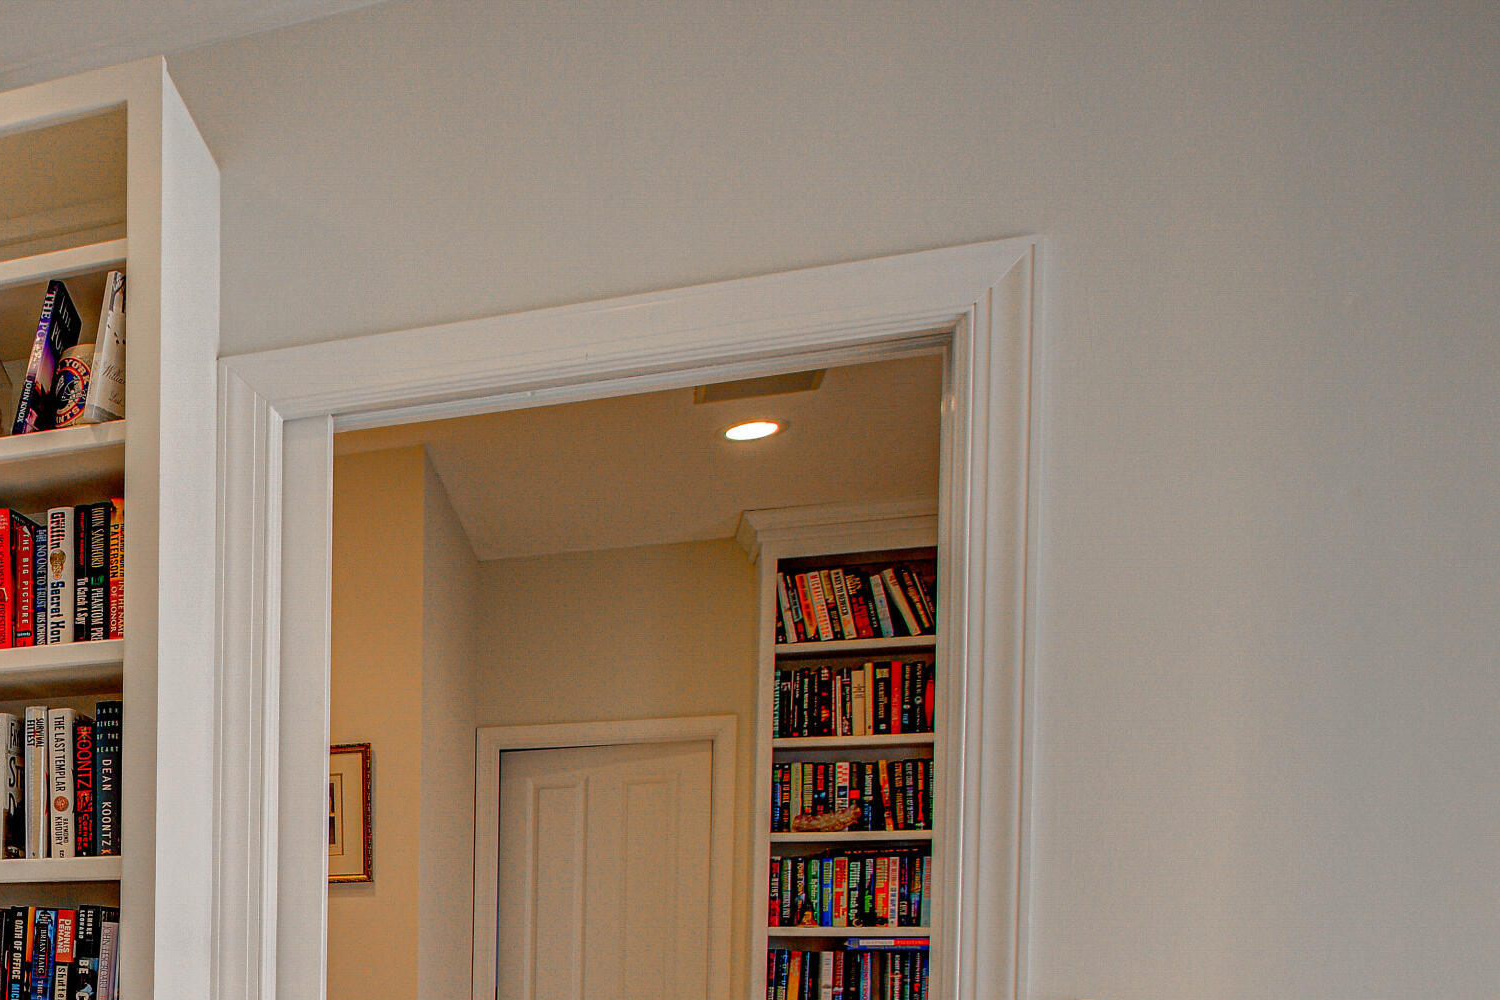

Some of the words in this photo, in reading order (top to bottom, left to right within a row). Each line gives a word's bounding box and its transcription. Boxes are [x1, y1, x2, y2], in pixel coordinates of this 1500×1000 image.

[22, 380, 33, 401] JOHN
[17, 401, 28, 424] KNOX
[110, 524, 119, 578] PATTERSON
[54, 716, 65, 731] THE
[55, 733, 66, 752] LAST
[76, 732, 92, 789] KOONTZ
[55, 755, 66, 792] TEMPLAR
[102, 759, 112, 791] DEAN
[102, 801, 111, 846] KOONTZ
[14, 919, 23, 938] OATH
[14, 940, 22, 951] OF
[11, 953, 22, 980] OFFICE
[78, 959, 87, 975] BE
